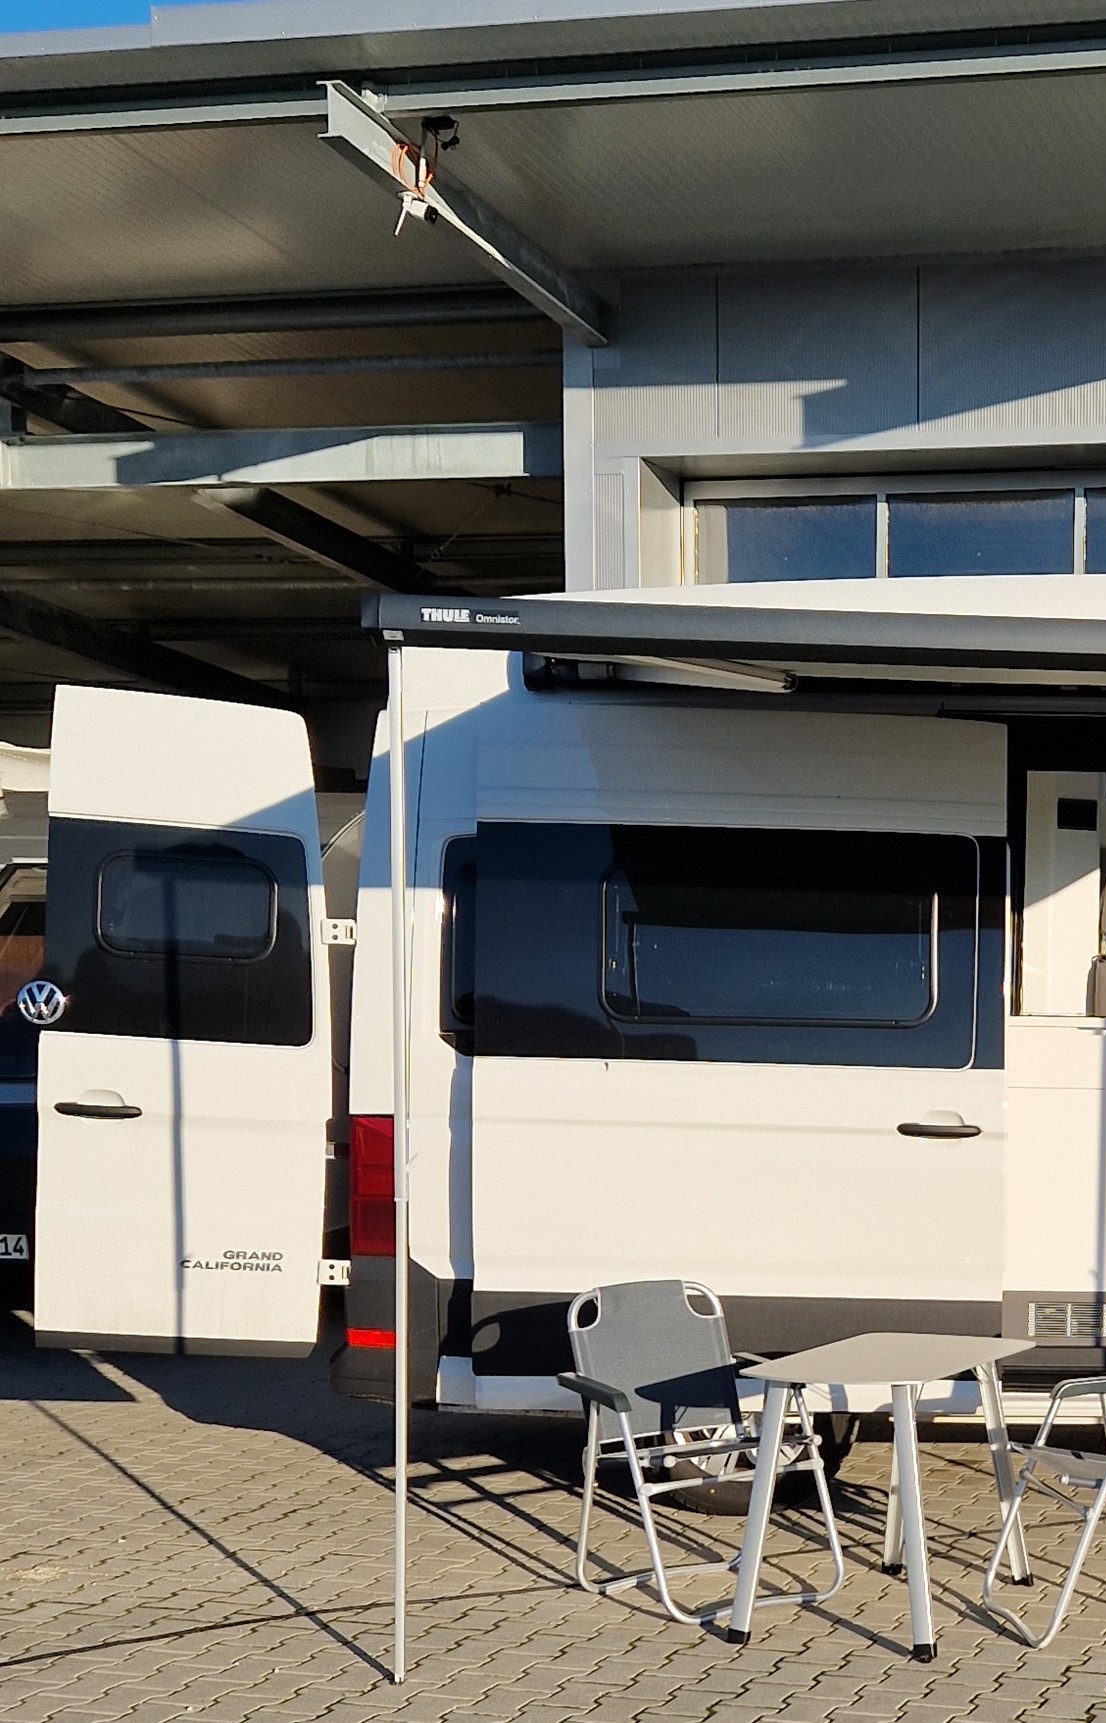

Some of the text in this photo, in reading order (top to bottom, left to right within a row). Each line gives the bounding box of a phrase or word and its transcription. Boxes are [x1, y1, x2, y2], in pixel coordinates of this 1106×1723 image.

[421, 608, 471, 623] THULE
[18, 981, 66, 1025] VW
[223, 1250, 284, 1261] GRAND
[180, 1259, 283, 1272] CALIFORNIA
